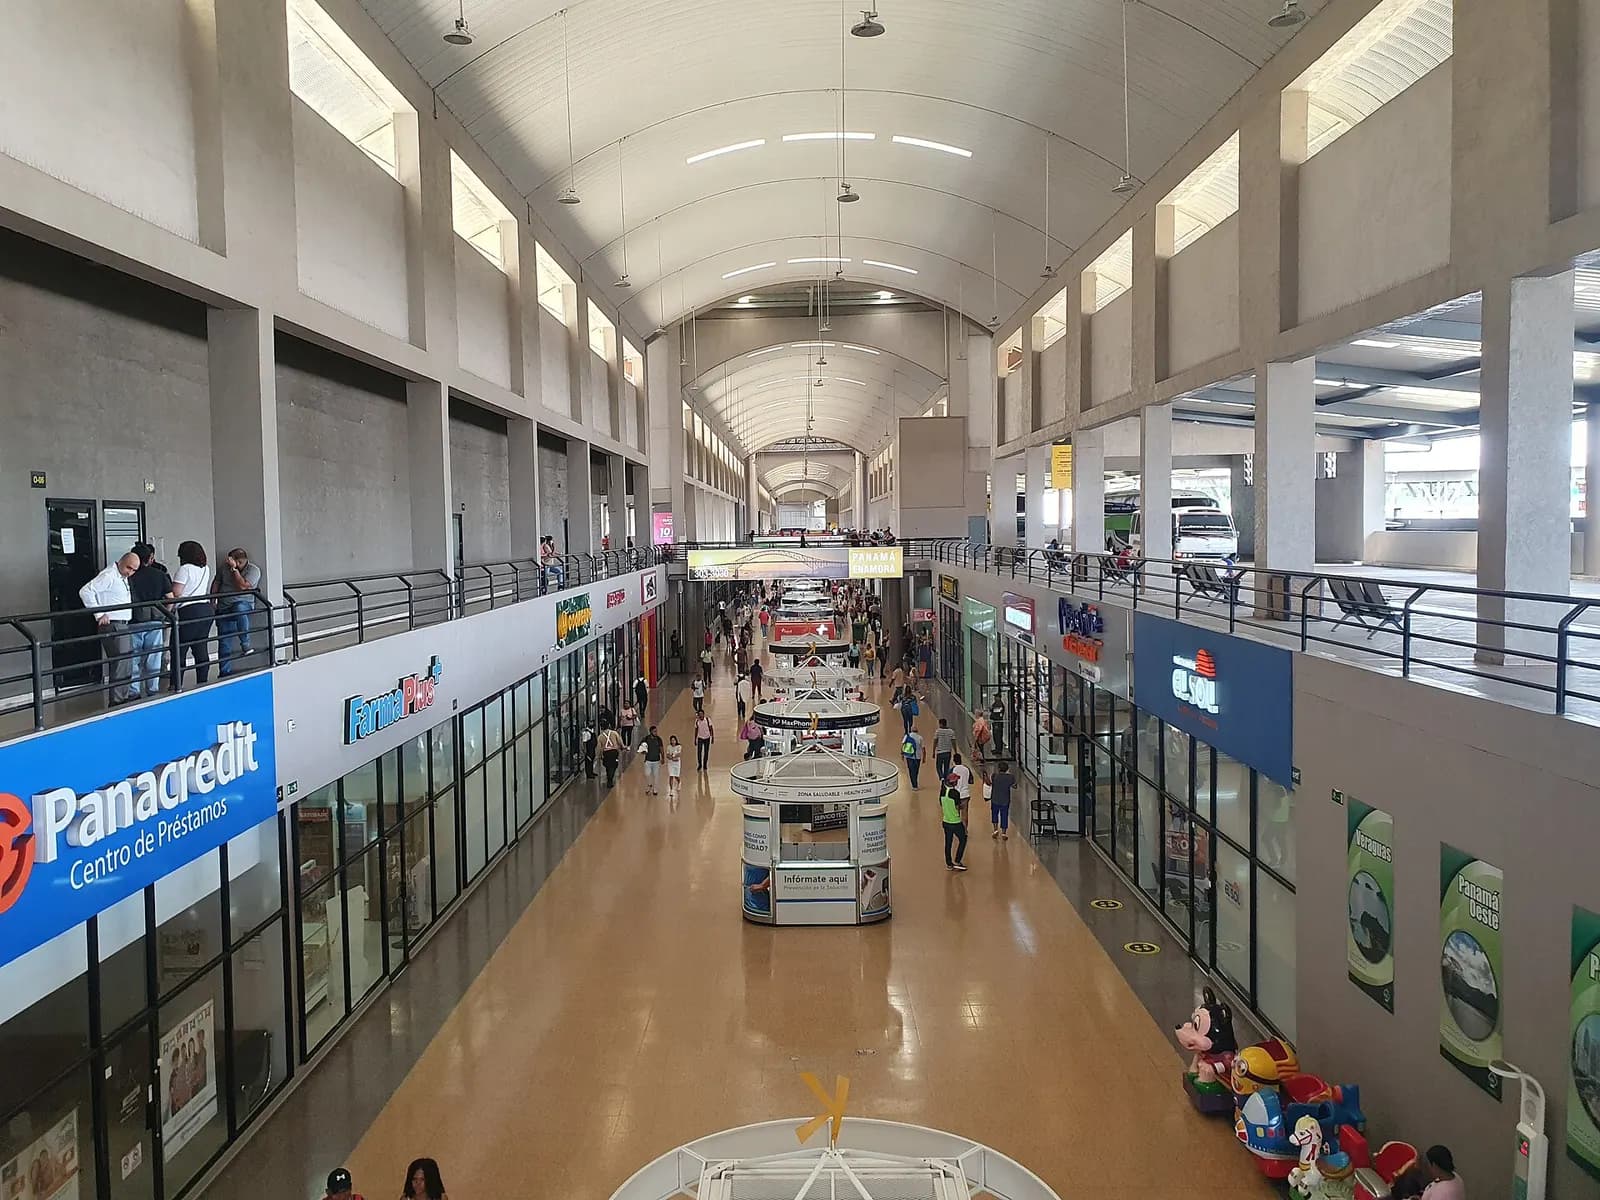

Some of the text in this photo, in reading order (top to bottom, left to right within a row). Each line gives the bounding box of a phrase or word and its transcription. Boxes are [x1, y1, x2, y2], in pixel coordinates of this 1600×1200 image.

[781, 719, 813, 727] MaxPhon
[33, 721, 259, 863] Panacredit
[70, 798, 228, 889] Centro de Préstamos
[1355, 829, 1392, 863] Veraguas
[784, 875, 826, 883] Infórmate
[1458, 873, 1500, 911] Panamá
[1468, 899, 1500, 931] Oeste
